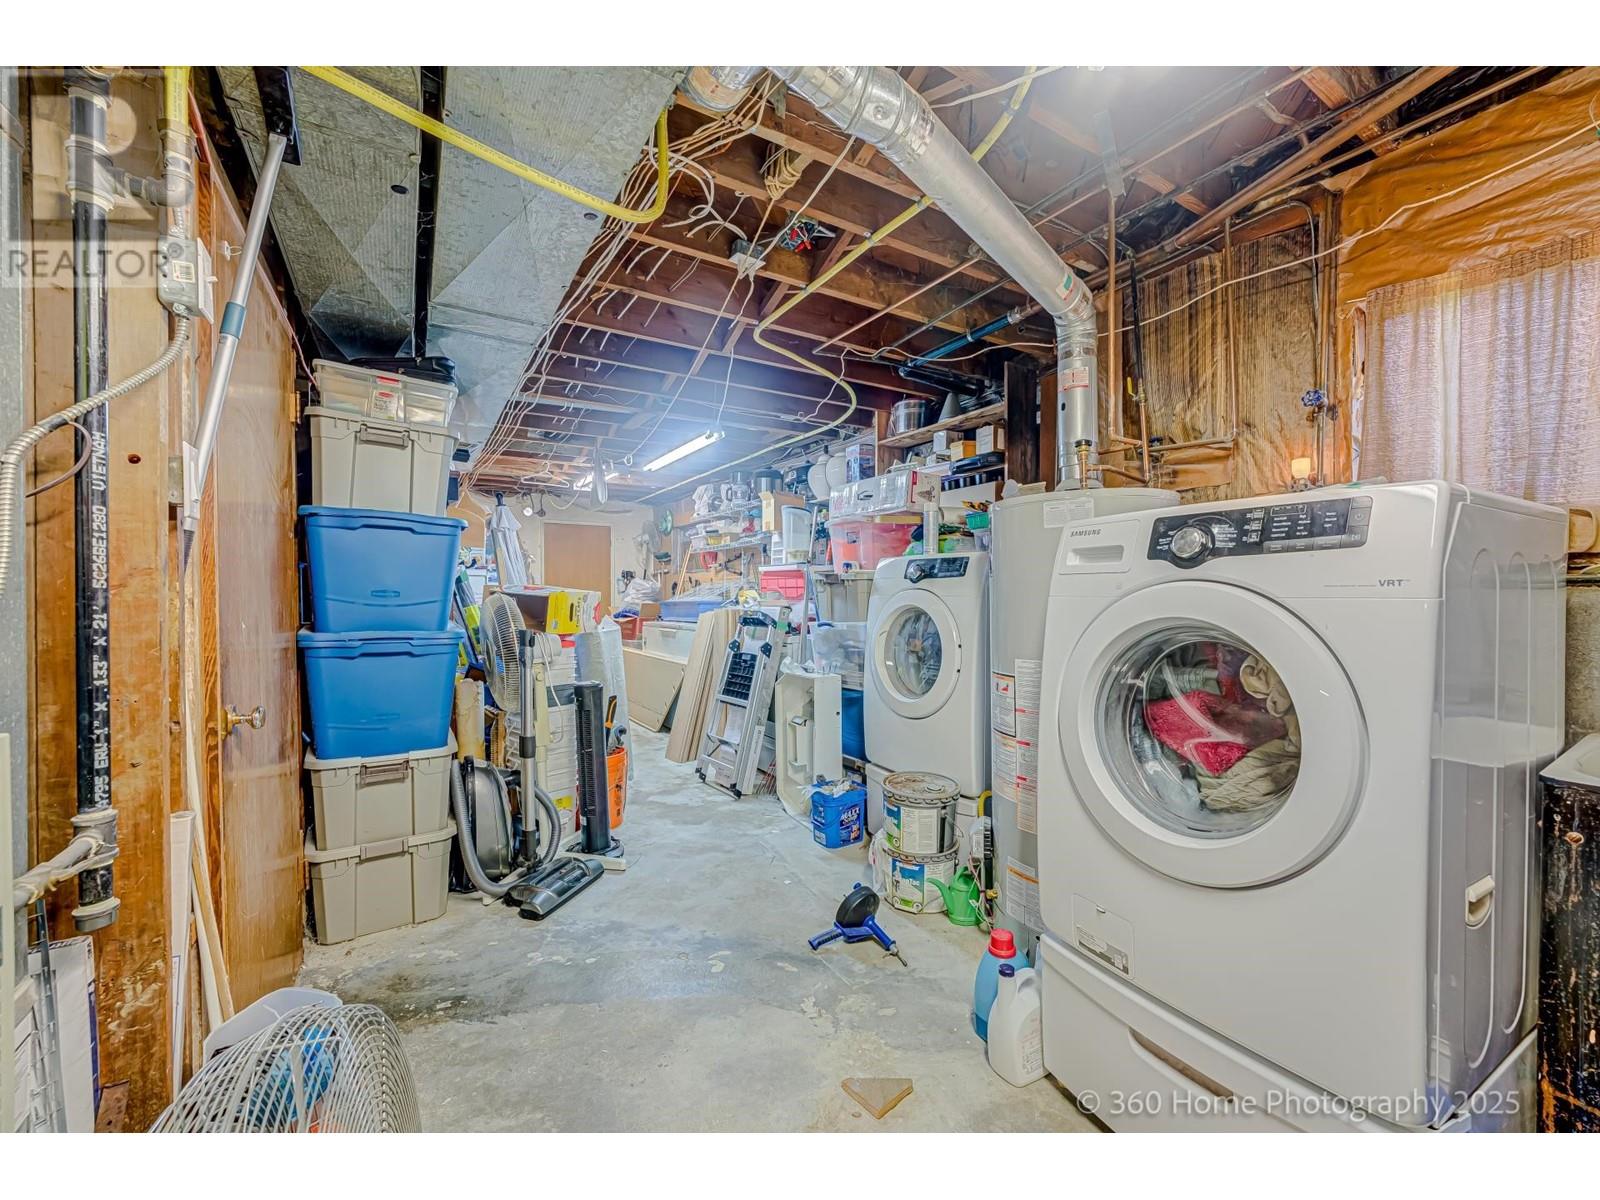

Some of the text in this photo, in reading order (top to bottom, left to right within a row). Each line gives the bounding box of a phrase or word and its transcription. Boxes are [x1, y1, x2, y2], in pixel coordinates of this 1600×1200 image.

[91, 431, 108, 492] VIETNAM
[1070, 528, 1102, 538] SAMSUNG
[93, 743, 109, 770] ERW
